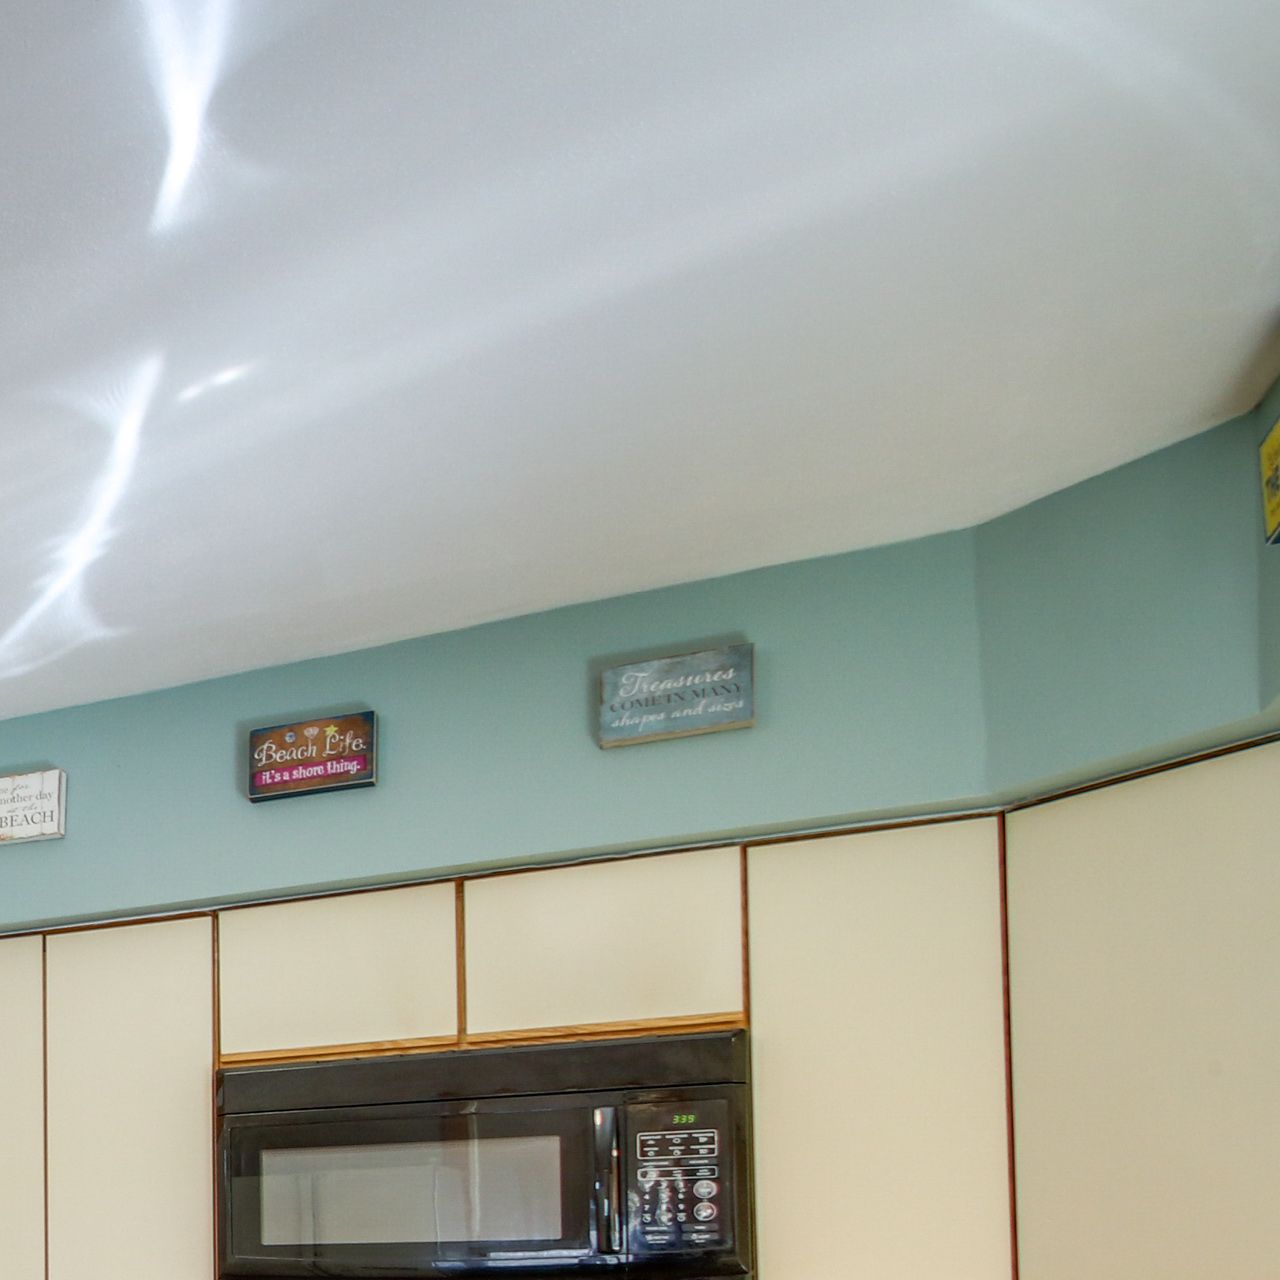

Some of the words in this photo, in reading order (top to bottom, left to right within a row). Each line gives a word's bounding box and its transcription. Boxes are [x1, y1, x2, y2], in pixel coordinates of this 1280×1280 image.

[619, 667, 735, 697] Treasures
[691, 682, 744, 700] MANY
[610, 710, 666, 732] shapes
[671, 699, 707, 719] and
[707, 700, 744, 713] sizes
[254, 739, 317, 767] Beach
[322, 730, 367, 757] Life.
[262, 769, 281, 785] it's
[283, 771, 290, 780] a
[292, 765, 325, 780] shore
[327, 759, 361, 775] thing.
[10, 783, 29, 796] for
[35, 790, 54, 802] day
[0, 810, 55, 828] BEACH
